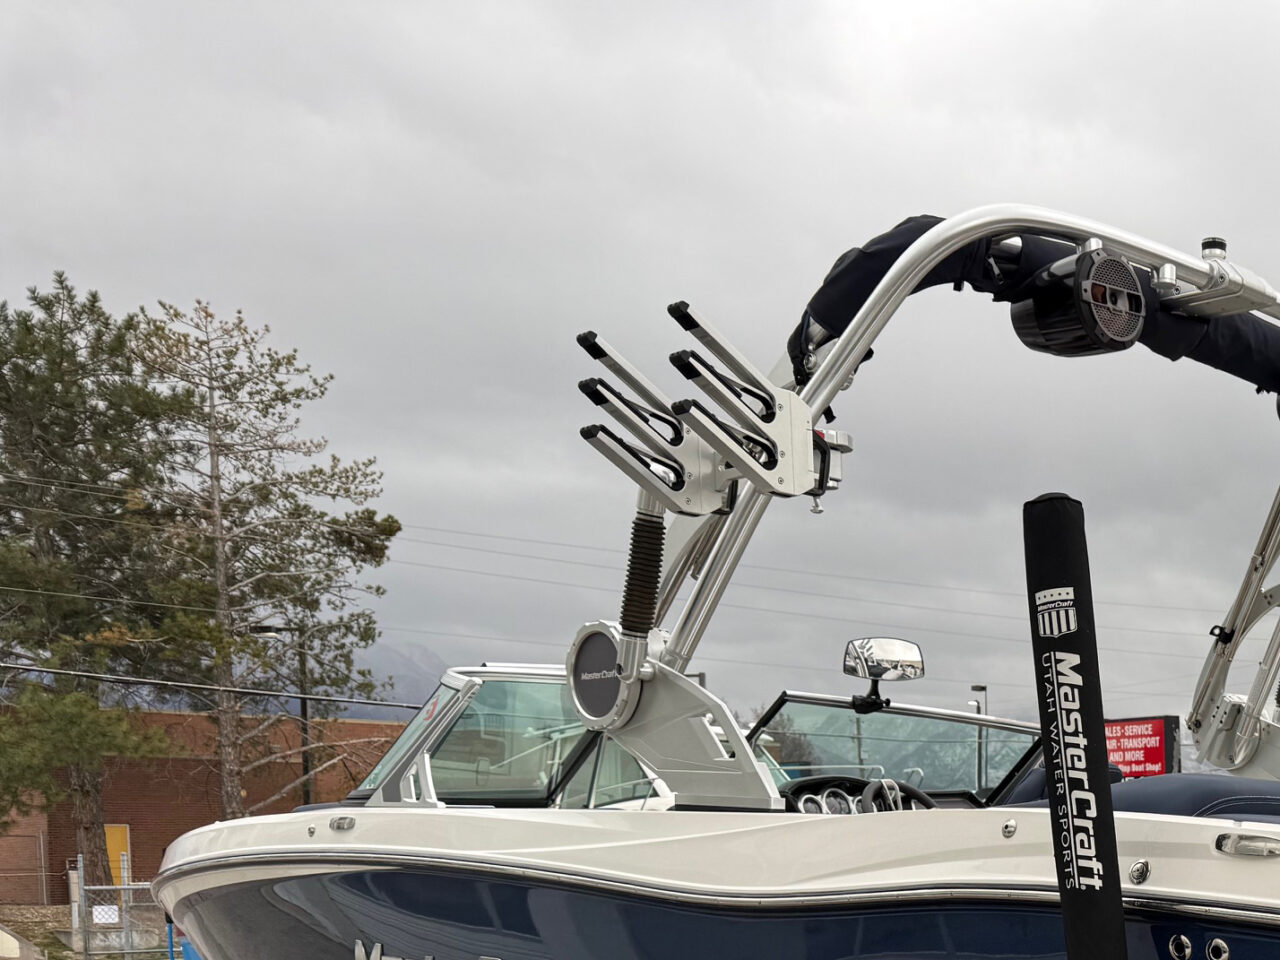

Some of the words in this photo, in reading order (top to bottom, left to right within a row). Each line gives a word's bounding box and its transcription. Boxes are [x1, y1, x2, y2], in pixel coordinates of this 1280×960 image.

[1042, 652, 1056, 712] UTAH
[1050, 721, 1065, 795] WATER
[1055, 651, 1104, 891] MasterCraft
[1110, 752, 1123, 762] AND
[1125, 750, 1145, 761] MORE
[1057, 804, 1075, 889] SPORTS
